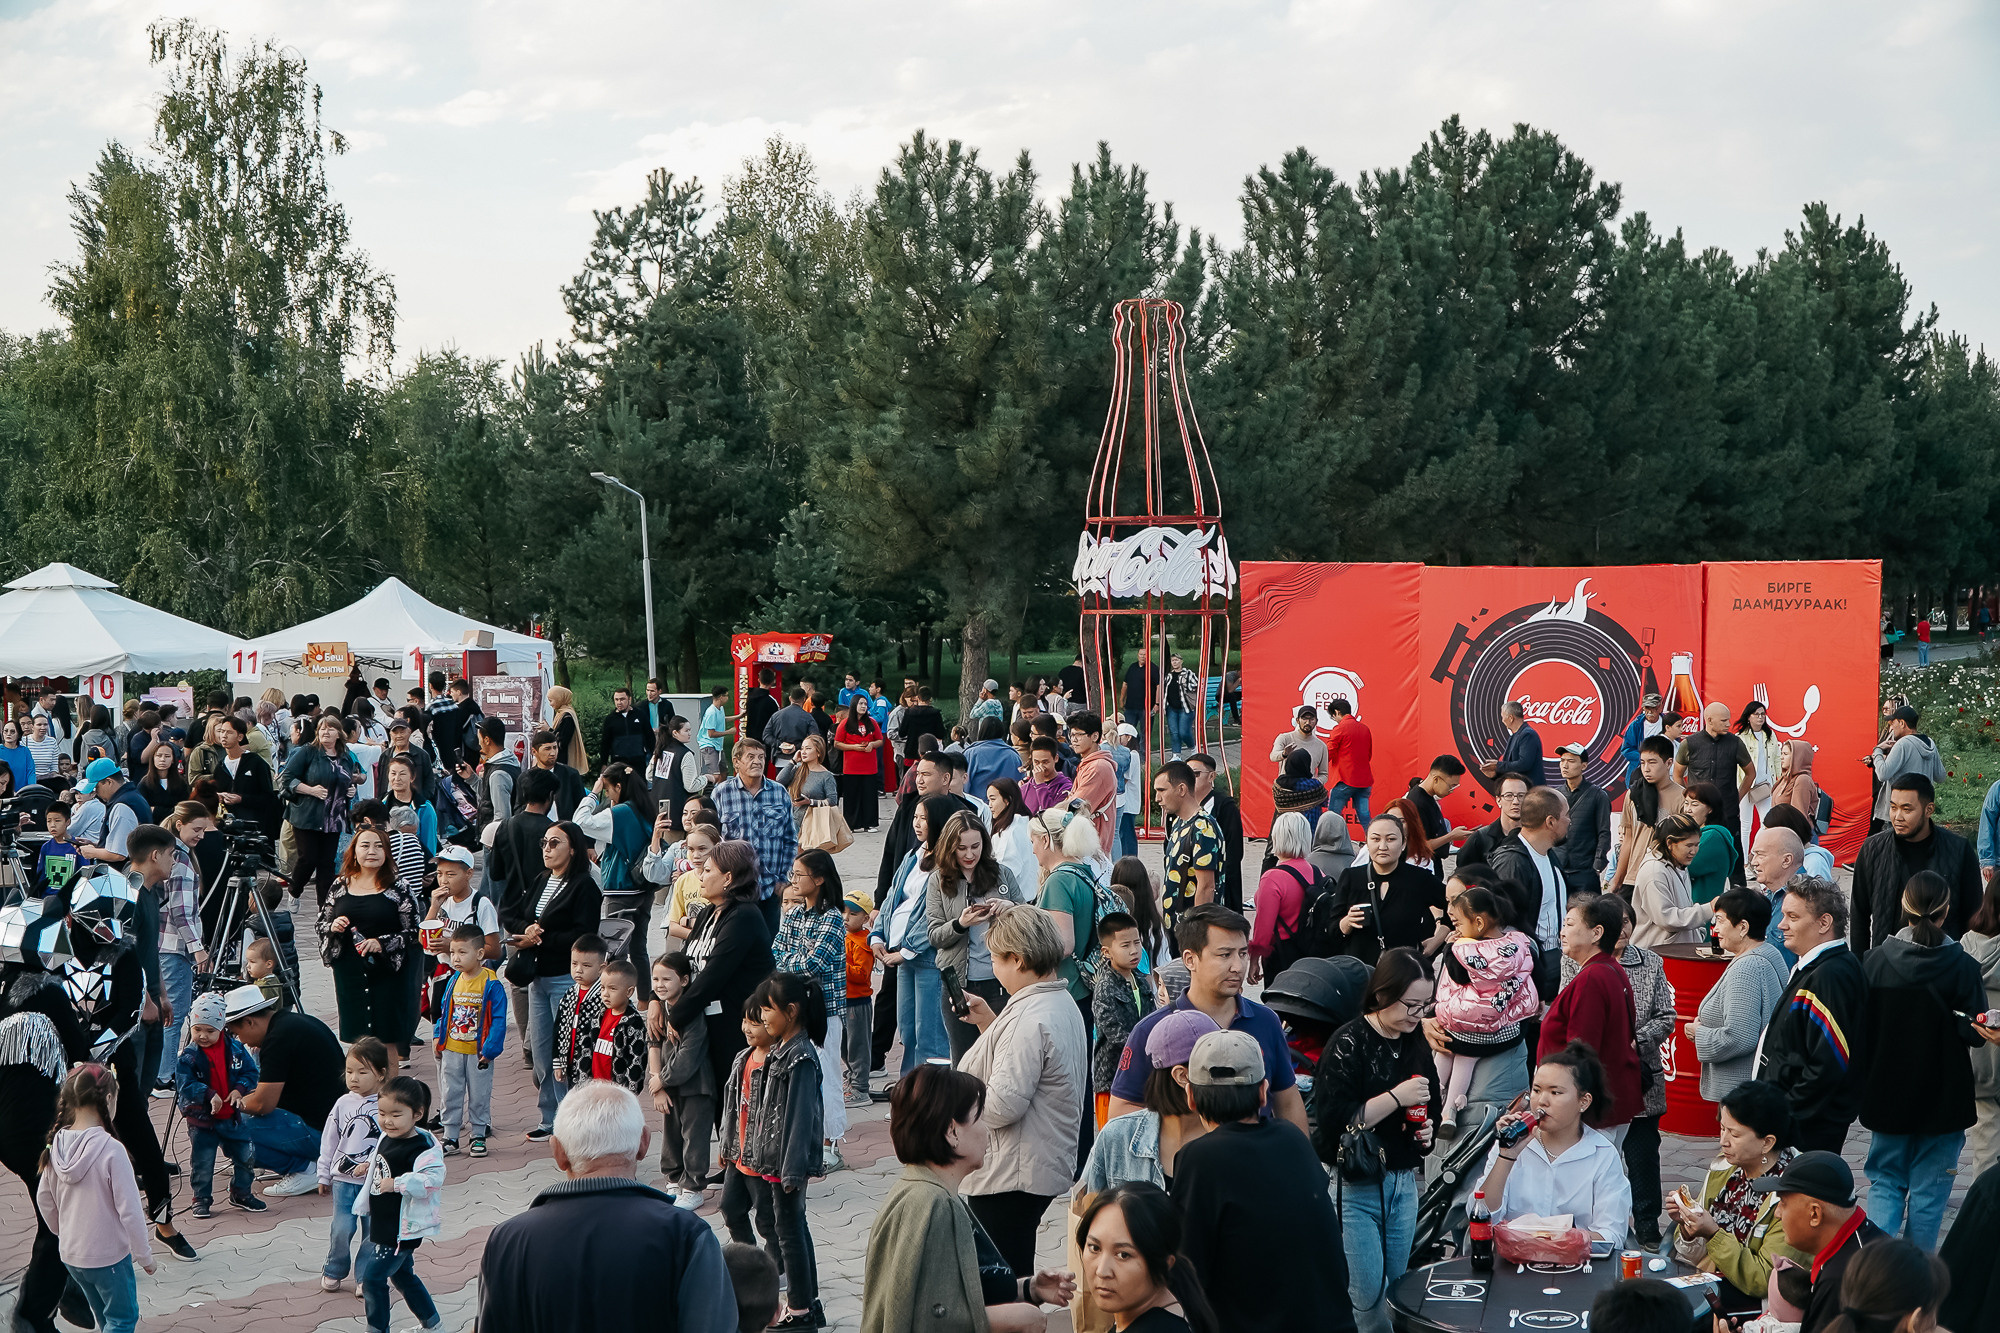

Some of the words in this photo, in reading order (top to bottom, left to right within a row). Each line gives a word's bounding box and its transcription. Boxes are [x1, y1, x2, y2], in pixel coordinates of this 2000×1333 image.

[1767, 582, 1812, 594] БИРГЕ
[1732, 599, 1847, 611] ДААМДУУРААК!
[232, 649, 258, 675] 11
[324, 652, 344, 663] Беш
[312, 664, 345, 674] Манты
[83, 674, 115, 700] 10
[1315, 692, 1347, 700] FOOD
[1315, 701, 1331, 711] FE
